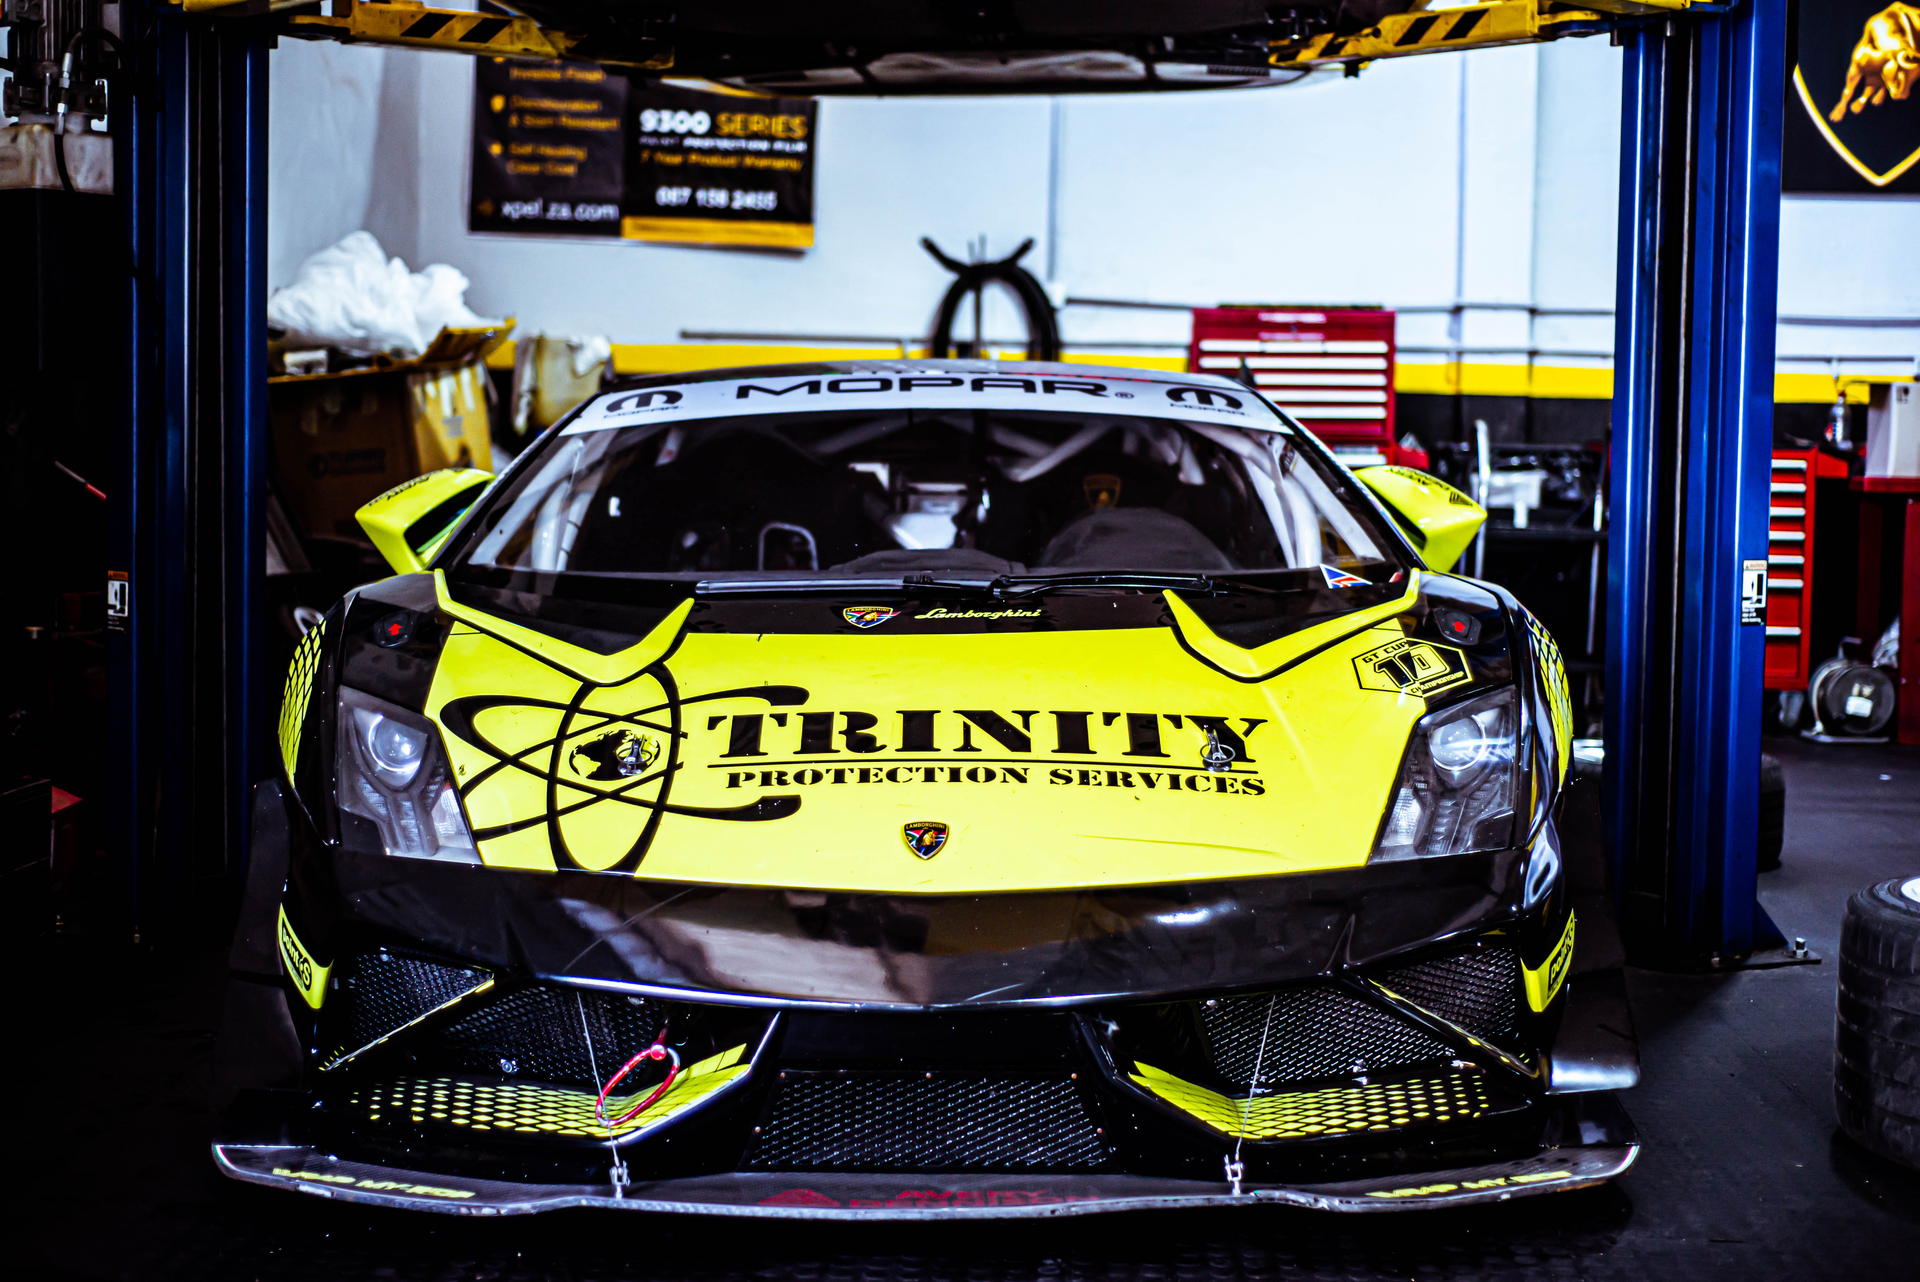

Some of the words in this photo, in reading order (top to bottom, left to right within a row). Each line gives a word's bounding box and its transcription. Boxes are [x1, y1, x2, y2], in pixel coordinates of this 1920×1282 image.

[639, 109, 711, 135] 9300
[715, 112, 808, 139] SERIES
[914, 607, 1041, 620] Lamborghini
[1362, 652, 1380, 664] GT
[1383, 641, 1408, 655] CUP
[1410, 671, 1465, 694] CHAMPIONSHIP
[707, 709, 1268, 763] TRINITY
[725, 766, 1031, 789] PROTECTION
[1049, 767, 1266, 796] SERVICES
[905, 822, 946, 830] LAMBORGHINI
